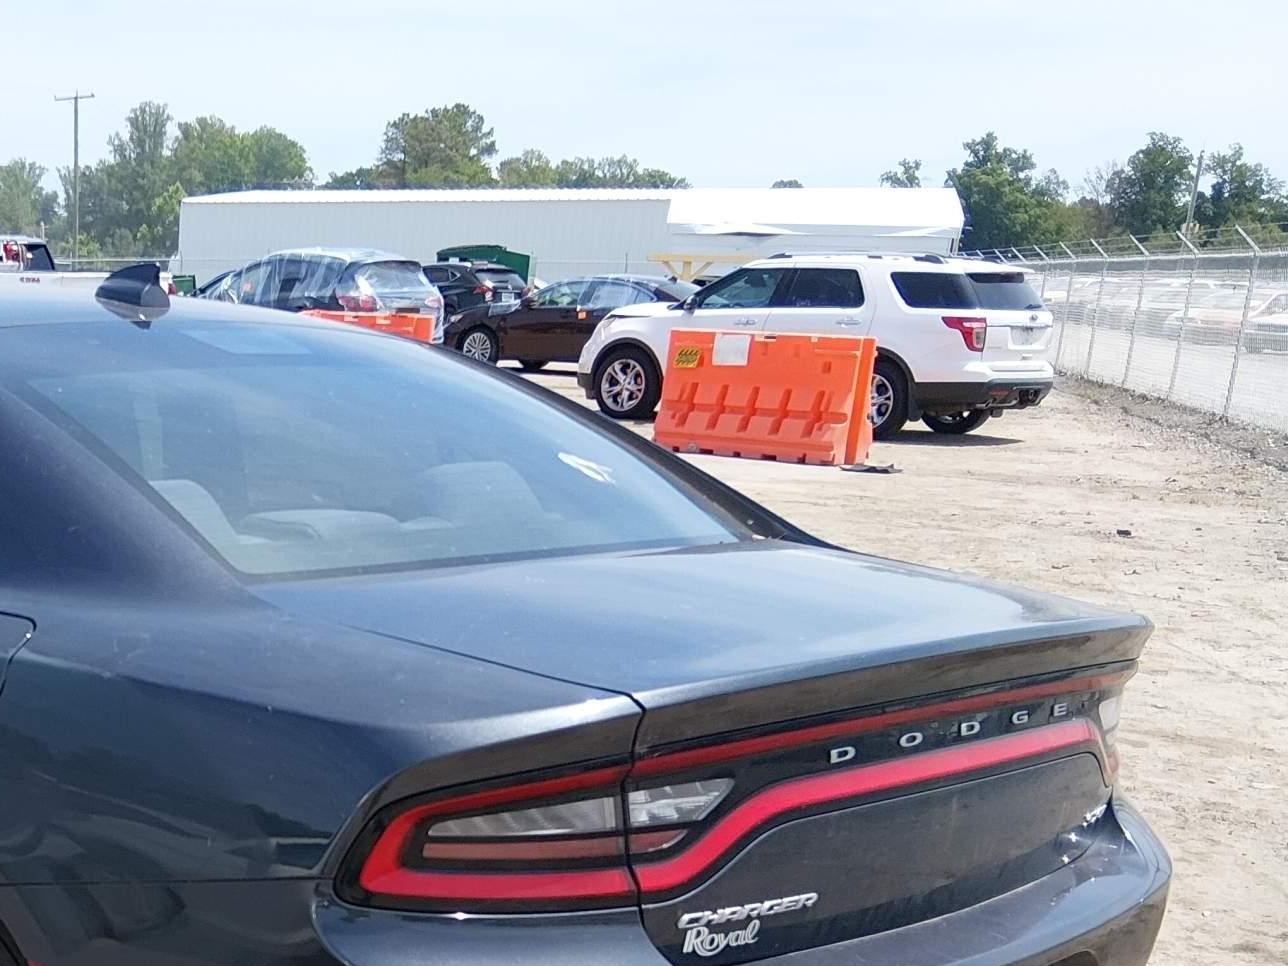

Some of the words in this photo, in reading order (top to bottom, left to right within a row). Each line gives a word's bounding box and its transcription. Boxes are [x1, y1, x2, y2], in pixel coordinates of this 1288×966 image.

[829, 702, 1069, 765] DODGE
[677, 892, 819, 930] CHARGER
[682, 918, 762, 957] Royal
